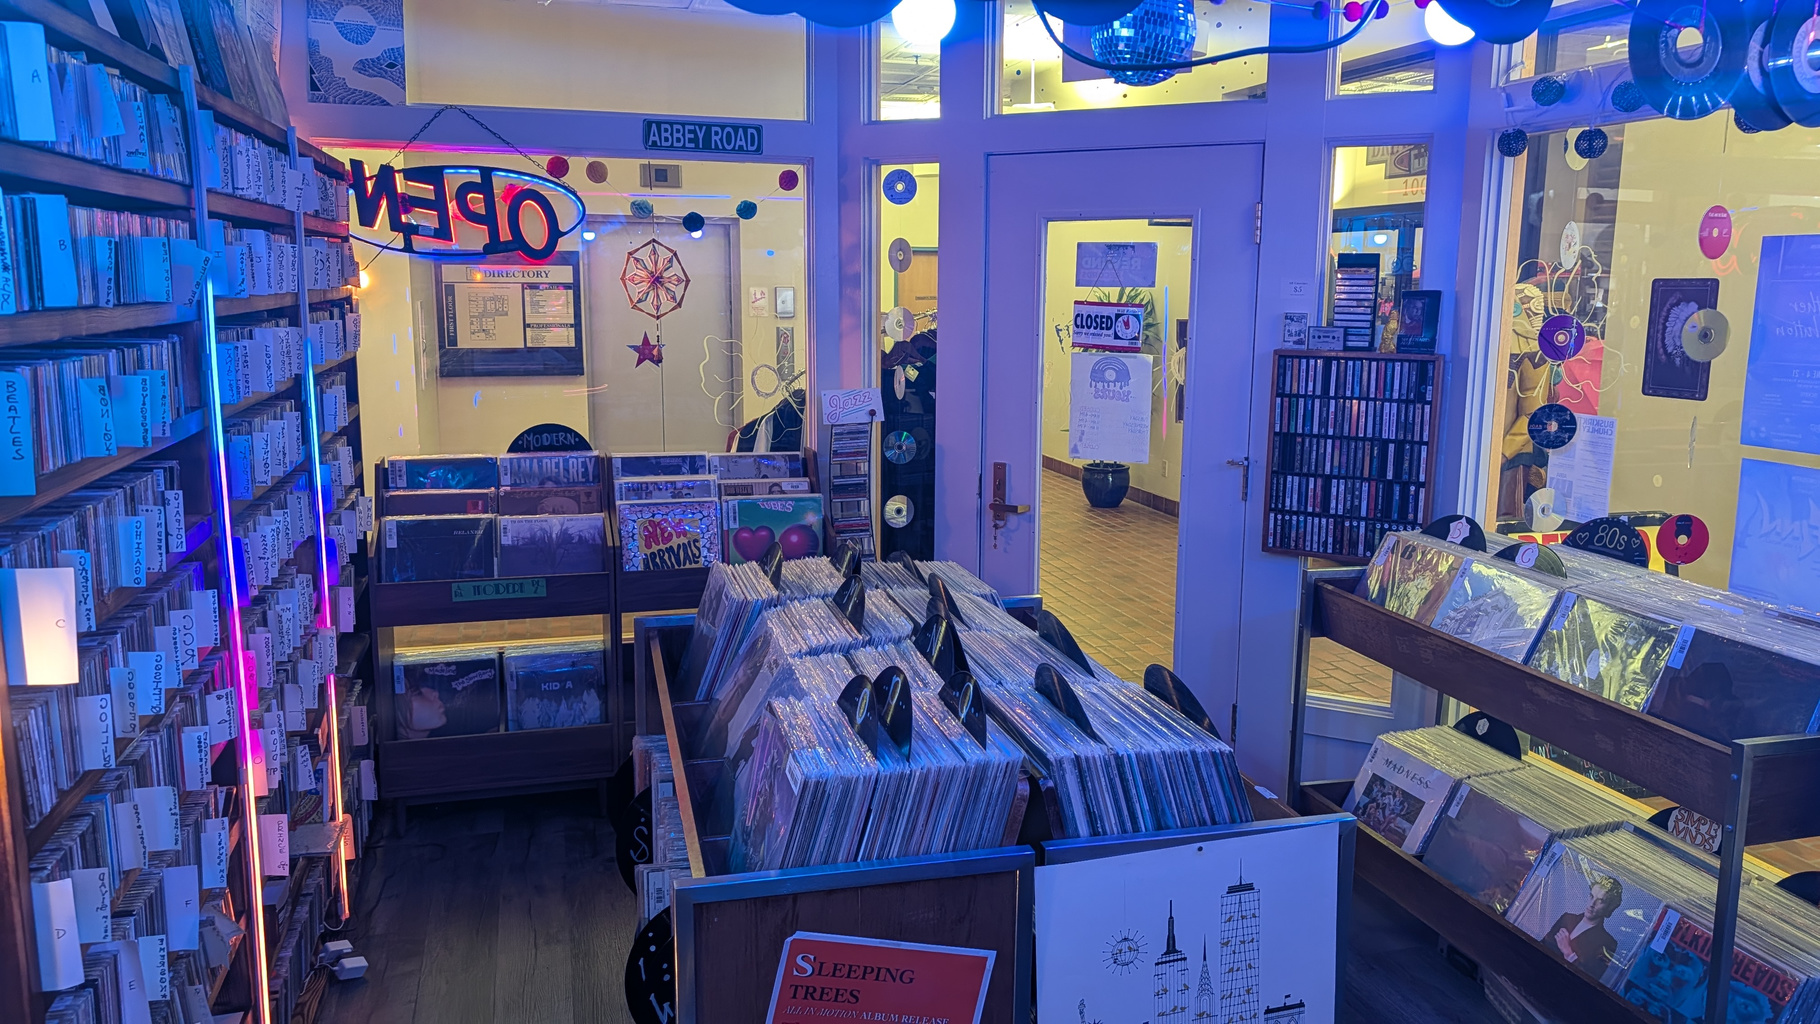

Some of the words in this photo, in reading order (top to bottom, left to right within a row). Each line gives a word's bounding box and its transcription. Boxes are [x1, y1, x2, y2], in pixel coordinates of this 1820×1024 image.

[32, 70, 41, 83] A
[649, 124, 706, 149] ABBEY
[712, 126, 758, 150] ROAD
[59, 240, 67, 250] B
[484, 270, 551, 278] DIRECTORY
[1074, 313, 1114, 330] CLOSED
[827, 391, 872, 423] Jazz
[6, 381, 24, 460] BEATLES
[523, 432, 576, 448] MODERN
[509, 458, 539, 484] ANA
[568, 457, 596, 482] REY
[757, 500, 795, 512] TUBES
[643, 518, 688, 550] NEW
[1450, 521, 1464, 538] B
[1594, 524, 1628, 550] 80s
[643, 539, 700, 570] ARRIVALS
[1521, 547, 1534, 564] C
[56, 619, 66, 628] C
[541, 682, 560, 690] KID
[1383, 757, 1434, 790] MADNESS
[55, 928, 66, 939] D
[793, 953, 915, 984] SLEEPING
[129, 980, 136, 990] E
[790, 984, 861, 1004] TREES
[783, 1006, 800, 1014] ALL
[802, 1007, 815, 1016] IN
[816, 1008, 858, 1018] MOTION
[860, 1011, 900, 1022] ALBUM
[902, 1014, 950, 1024] RELEASE
